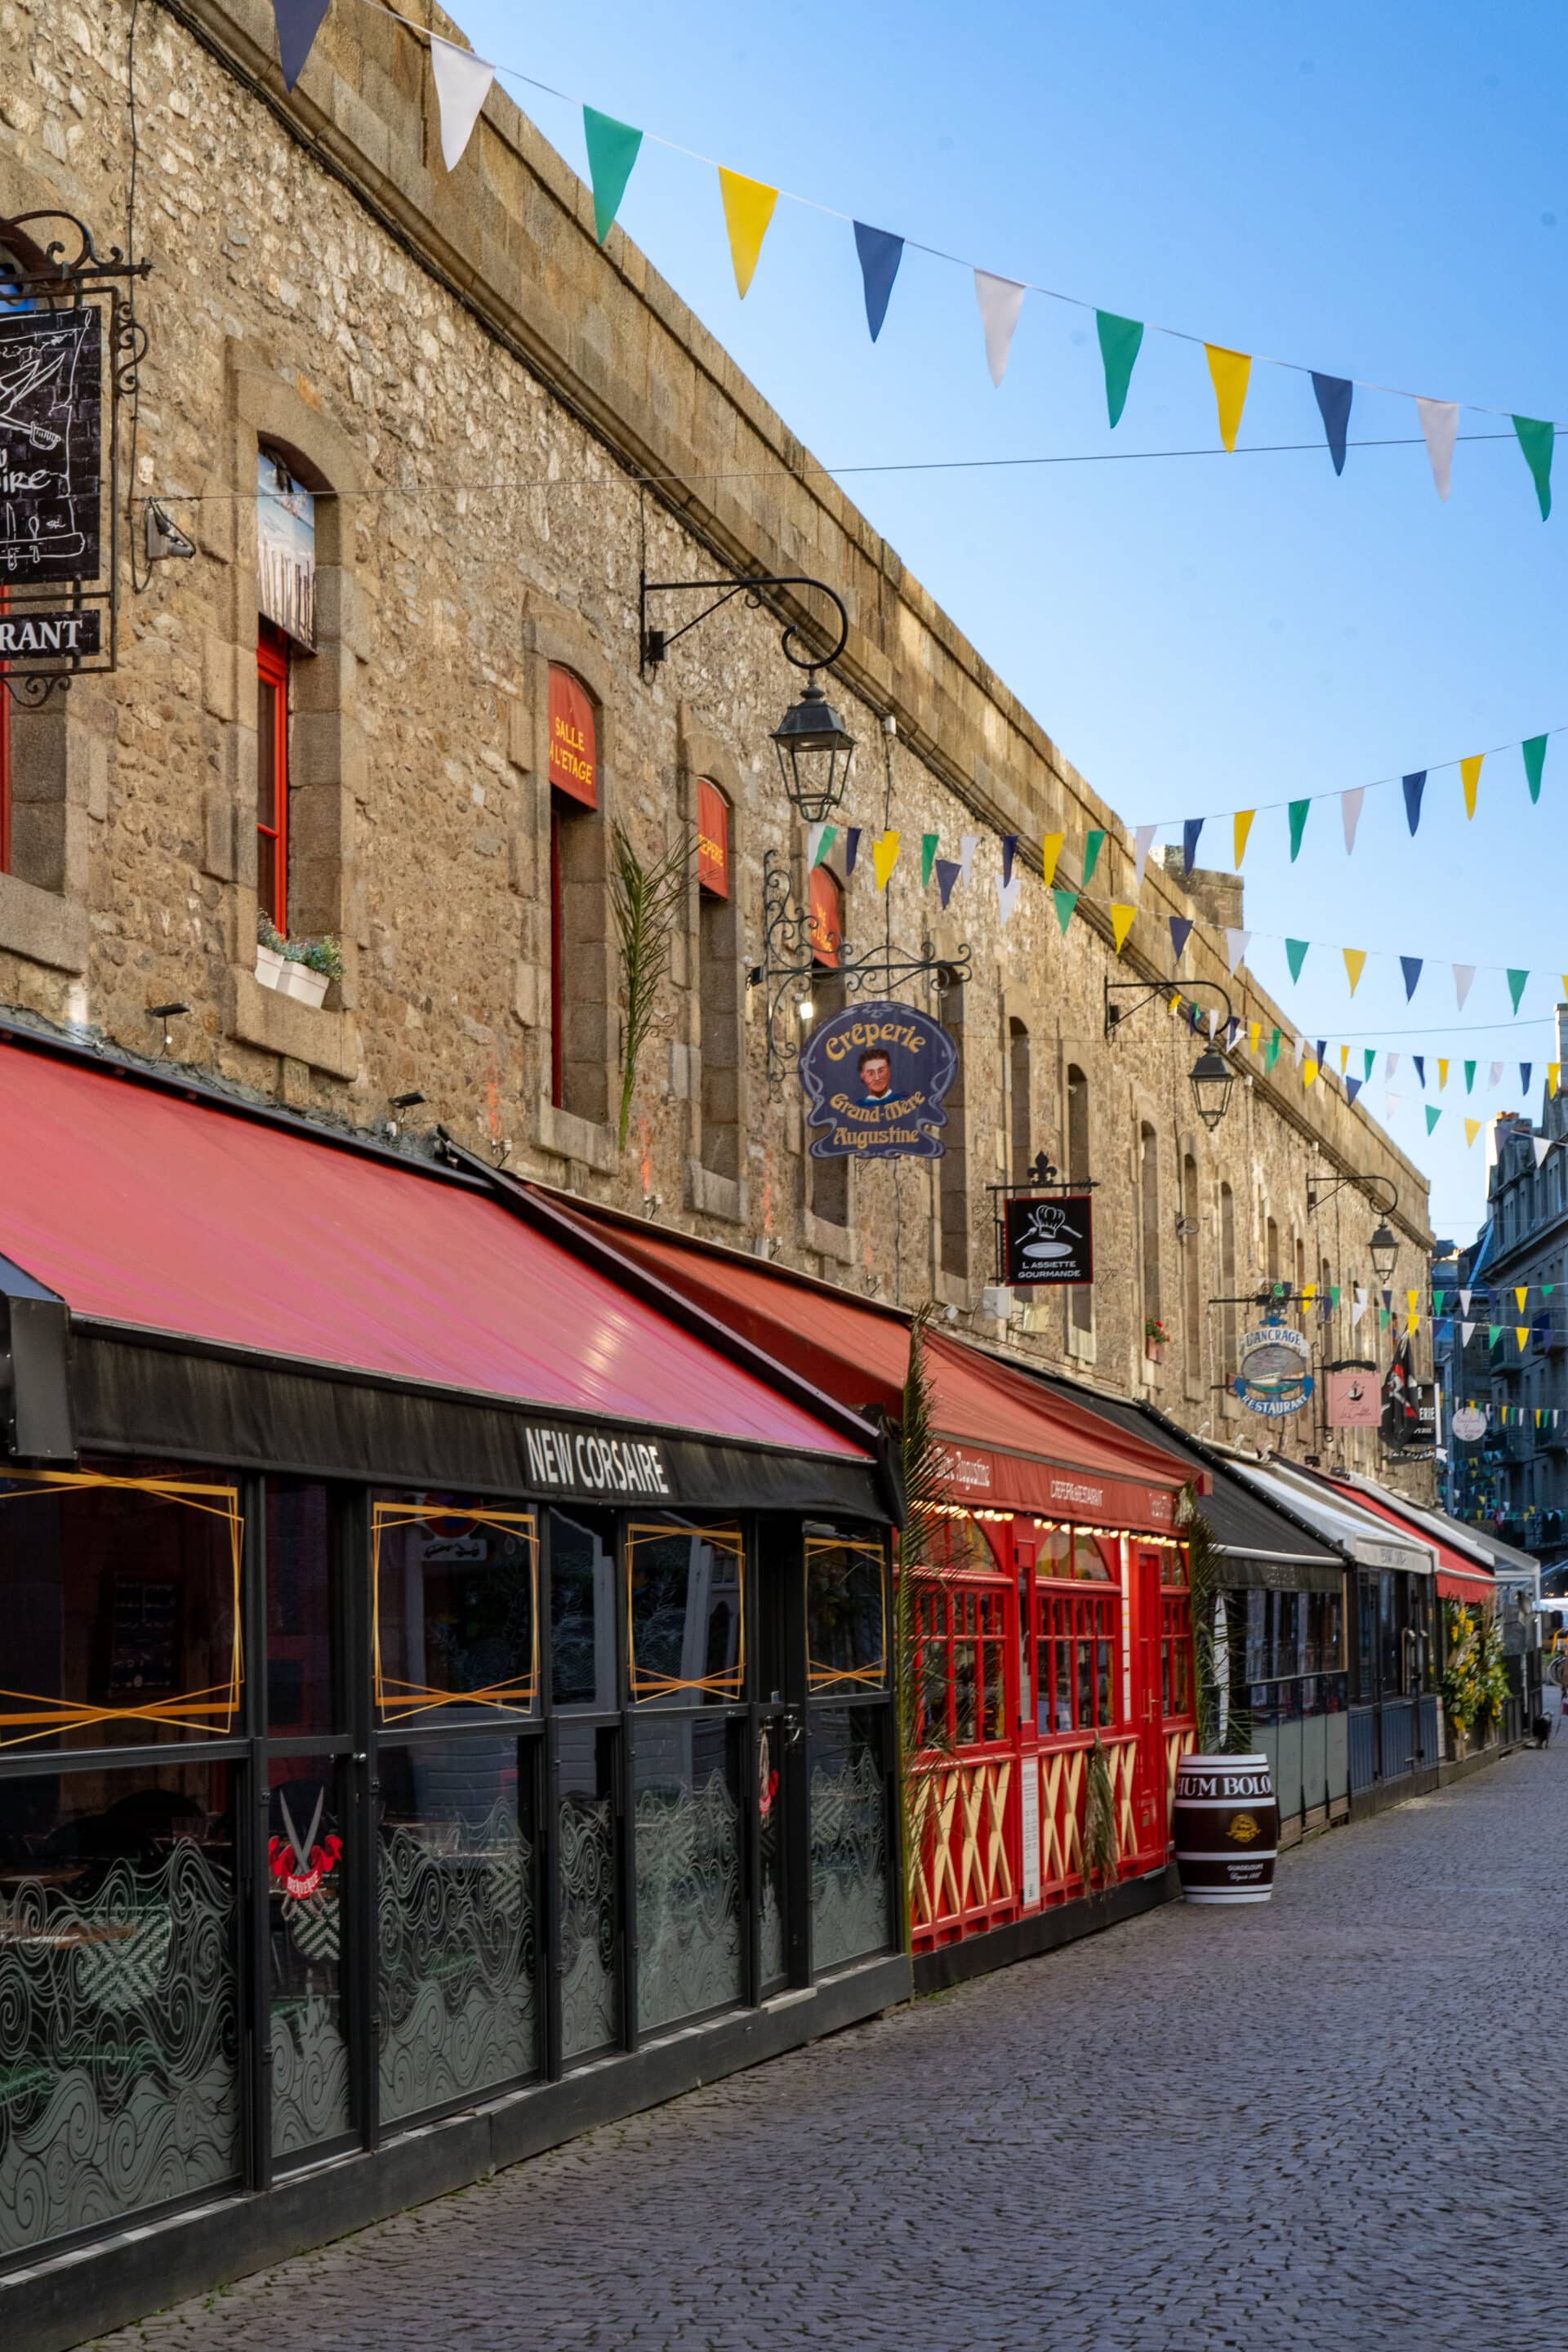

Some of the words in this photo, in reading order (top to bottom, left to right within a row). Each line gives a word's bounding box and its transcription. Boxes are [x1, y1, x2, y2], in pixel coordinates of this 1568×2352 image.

[555, 716, 585, 751] SALLE
[833, 1124, 920, 1149] Augustine
[1018, 1269, 1082, 1279] GOURMANDE
[1245, 1329, 1302, 1347] L'ANCRAGE
[1241, 1393, 1308, 1414] RESTAURANT
[525, 1427, 575, 1486] NEW
[575, 1434, 670, 1494] CORSAIRE
